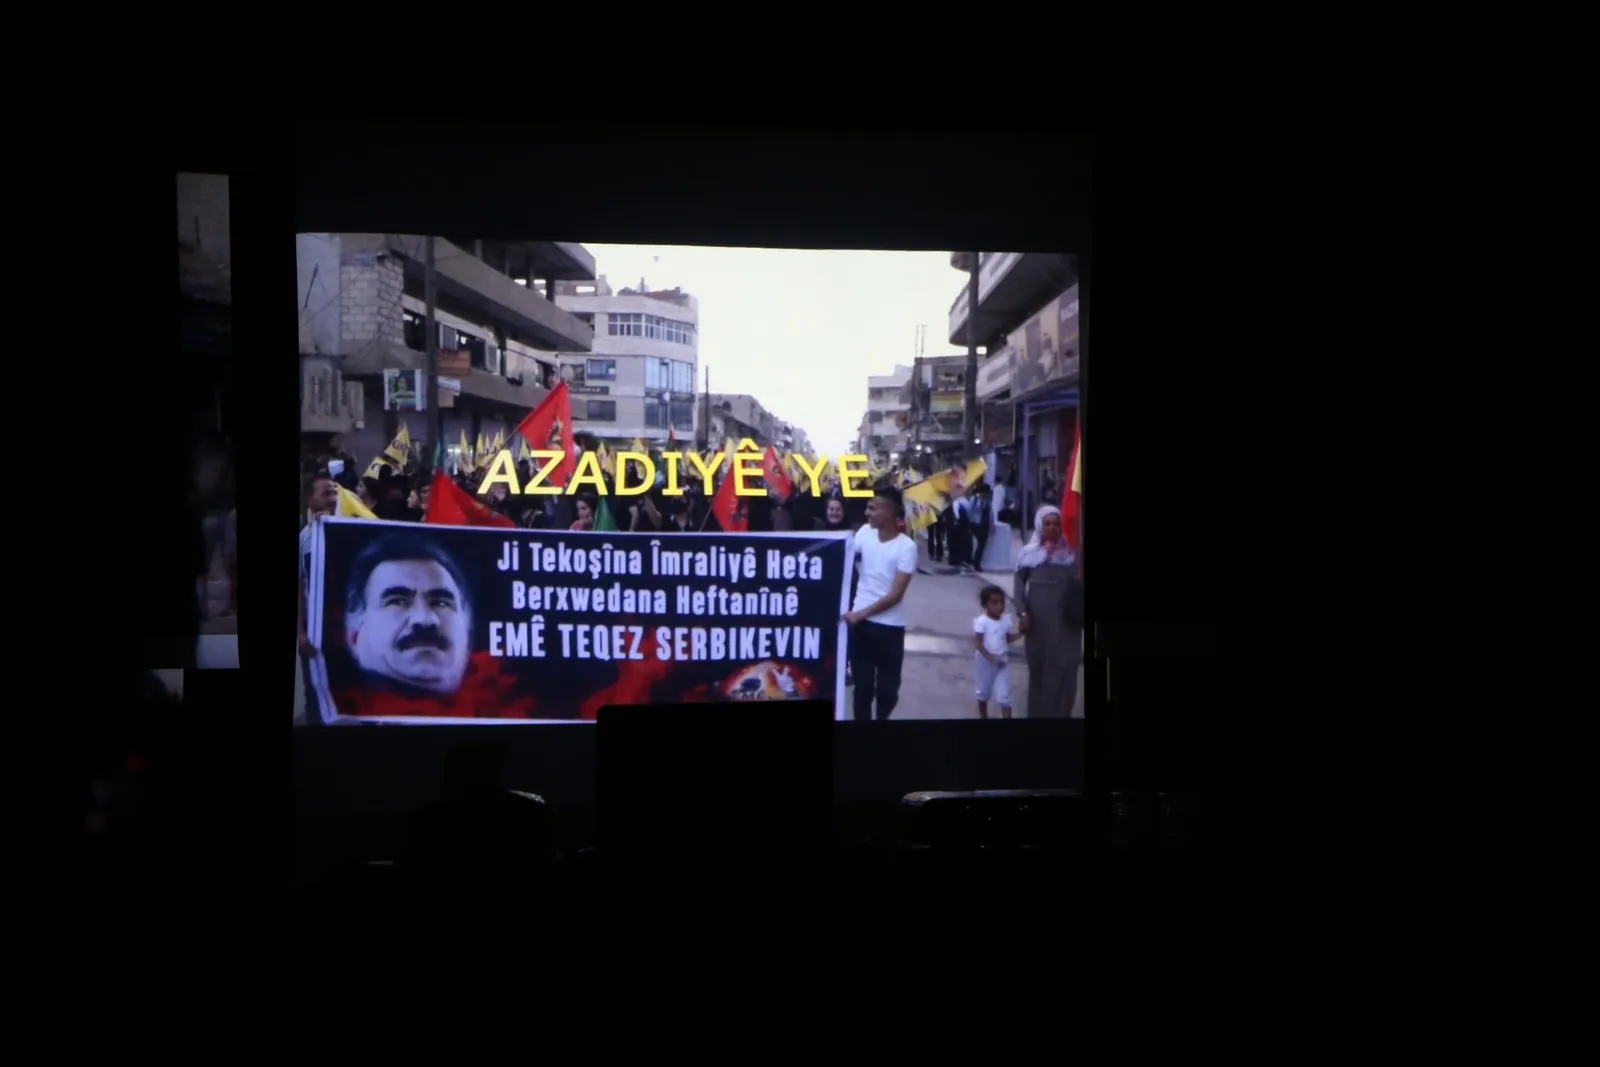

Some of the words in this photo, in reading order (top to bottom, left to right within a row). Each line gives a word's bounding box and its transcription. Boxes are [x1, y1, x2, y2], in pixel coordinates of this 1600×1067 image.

[477, 438, 768, 497] AZADIYÊ
[792, 453, 875, 498] YE
[497, 541, 519, 572] Ji
[529, 542, 642, 579] Tekoşîna
[651, 540, 757, 583] Îmraliyê
[766, 549, 823, 580] Heta
[512, 581, 667, 615] Berxwedana
[676, 585, 799, 616] Heftanînê
[489, 615, 546, 658] EMÊ
[557, 623, 645, 662] TEQEZ
[655, 626, 821, 662] SERBIKEVIN
